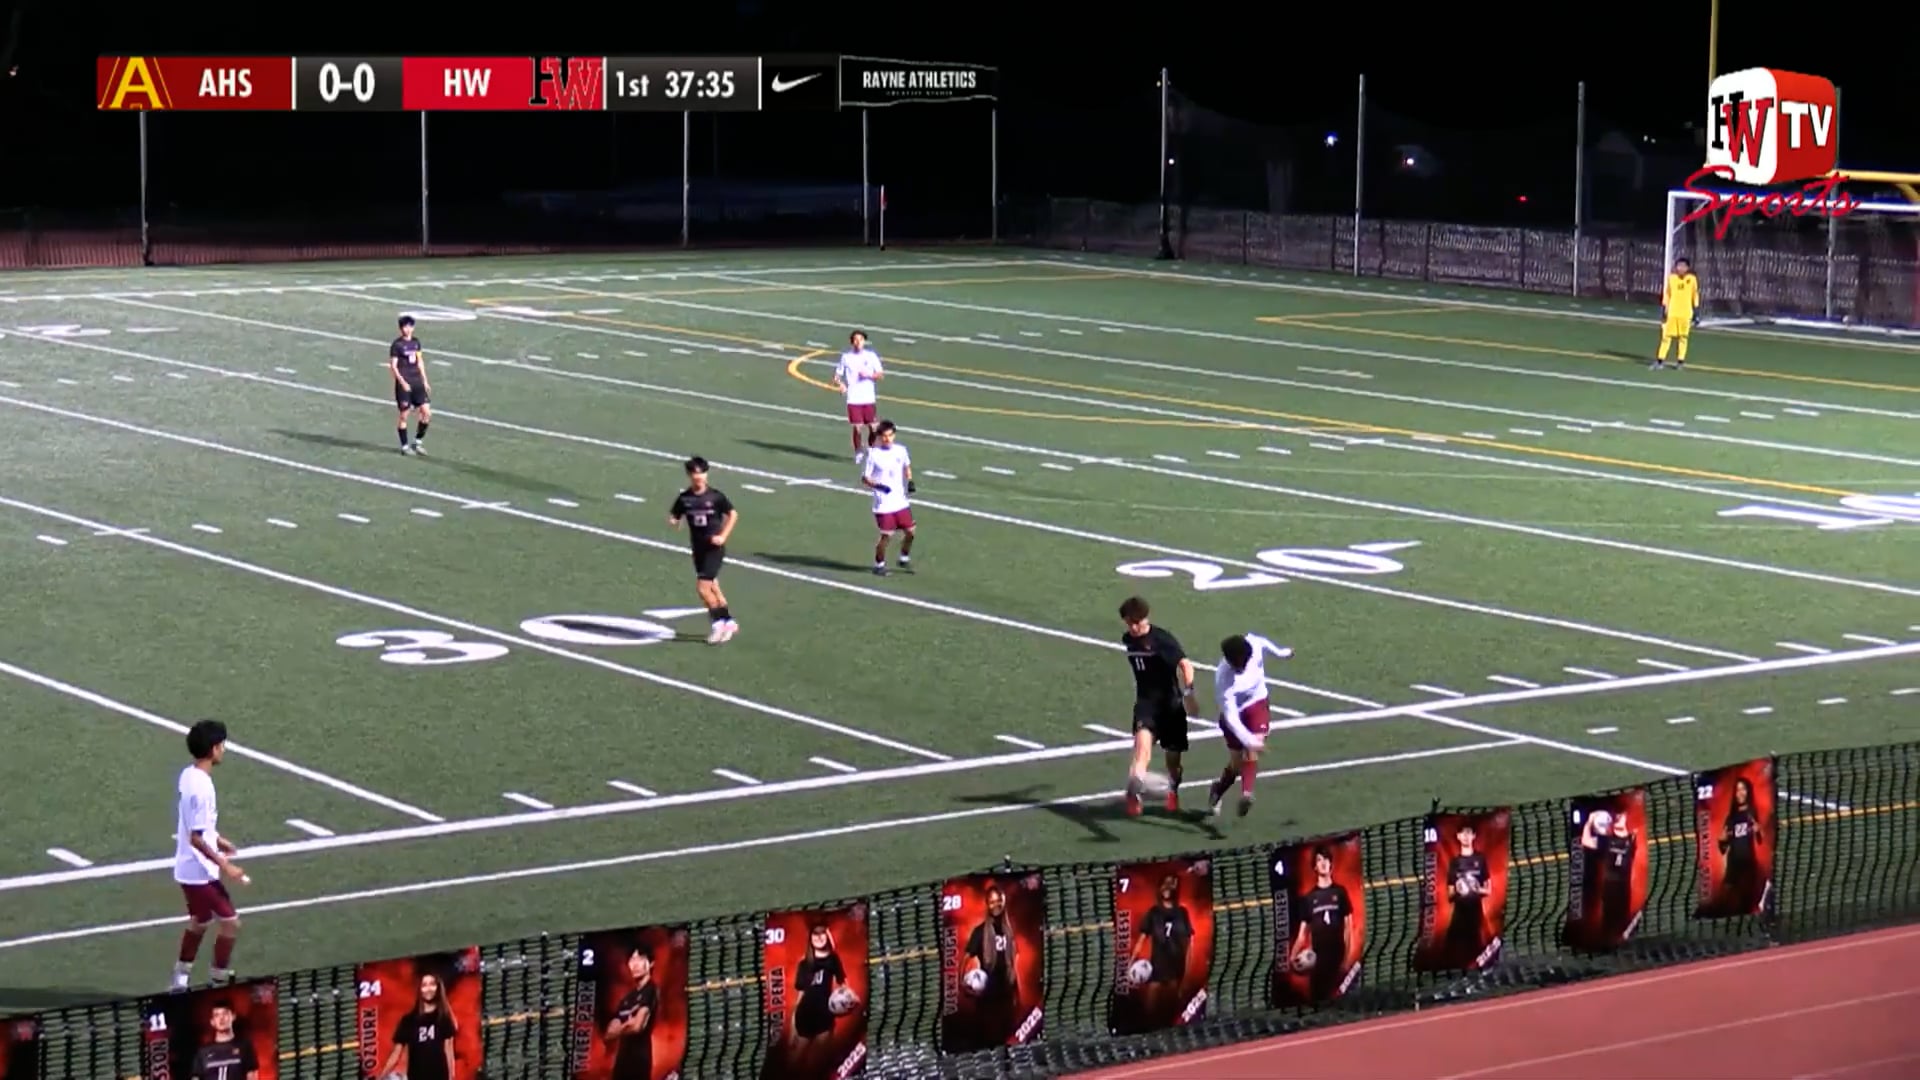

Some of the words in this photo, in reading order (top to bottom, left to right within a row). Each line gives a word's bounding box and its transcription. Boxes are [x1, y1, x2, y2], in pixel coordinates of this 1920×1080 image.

[1135, 657, 1146, 671] 11
[1697, 785, 1713, 800] 22
[1274, 860, 1284, 876] 4
[1119, 878, 1130, 893] 7
[942, 894, 962, 912] 28
[1323, 911, 1331, 925] 4
[764, 928, 785, 945] 30
[1116, 909, 1131, 952] REESE
[1165, 922, 1173, 937] 7
[944, 926, 959, 970] PUGH
[582, 949, 594, 966] 2
[359, 980, 382, 998] 24
[768, 965, 785, 1008] PENA
[576, 980, 597, 1023] PARK
[149, 1012, 167, 1031] 11
[1015, 1006, 1042, 1043] 2025
[361, 1006, 379, 1072] OZTURK
[418, 1024, 435, 1042] 24
[836, 1042, 867, 1078] 2025
